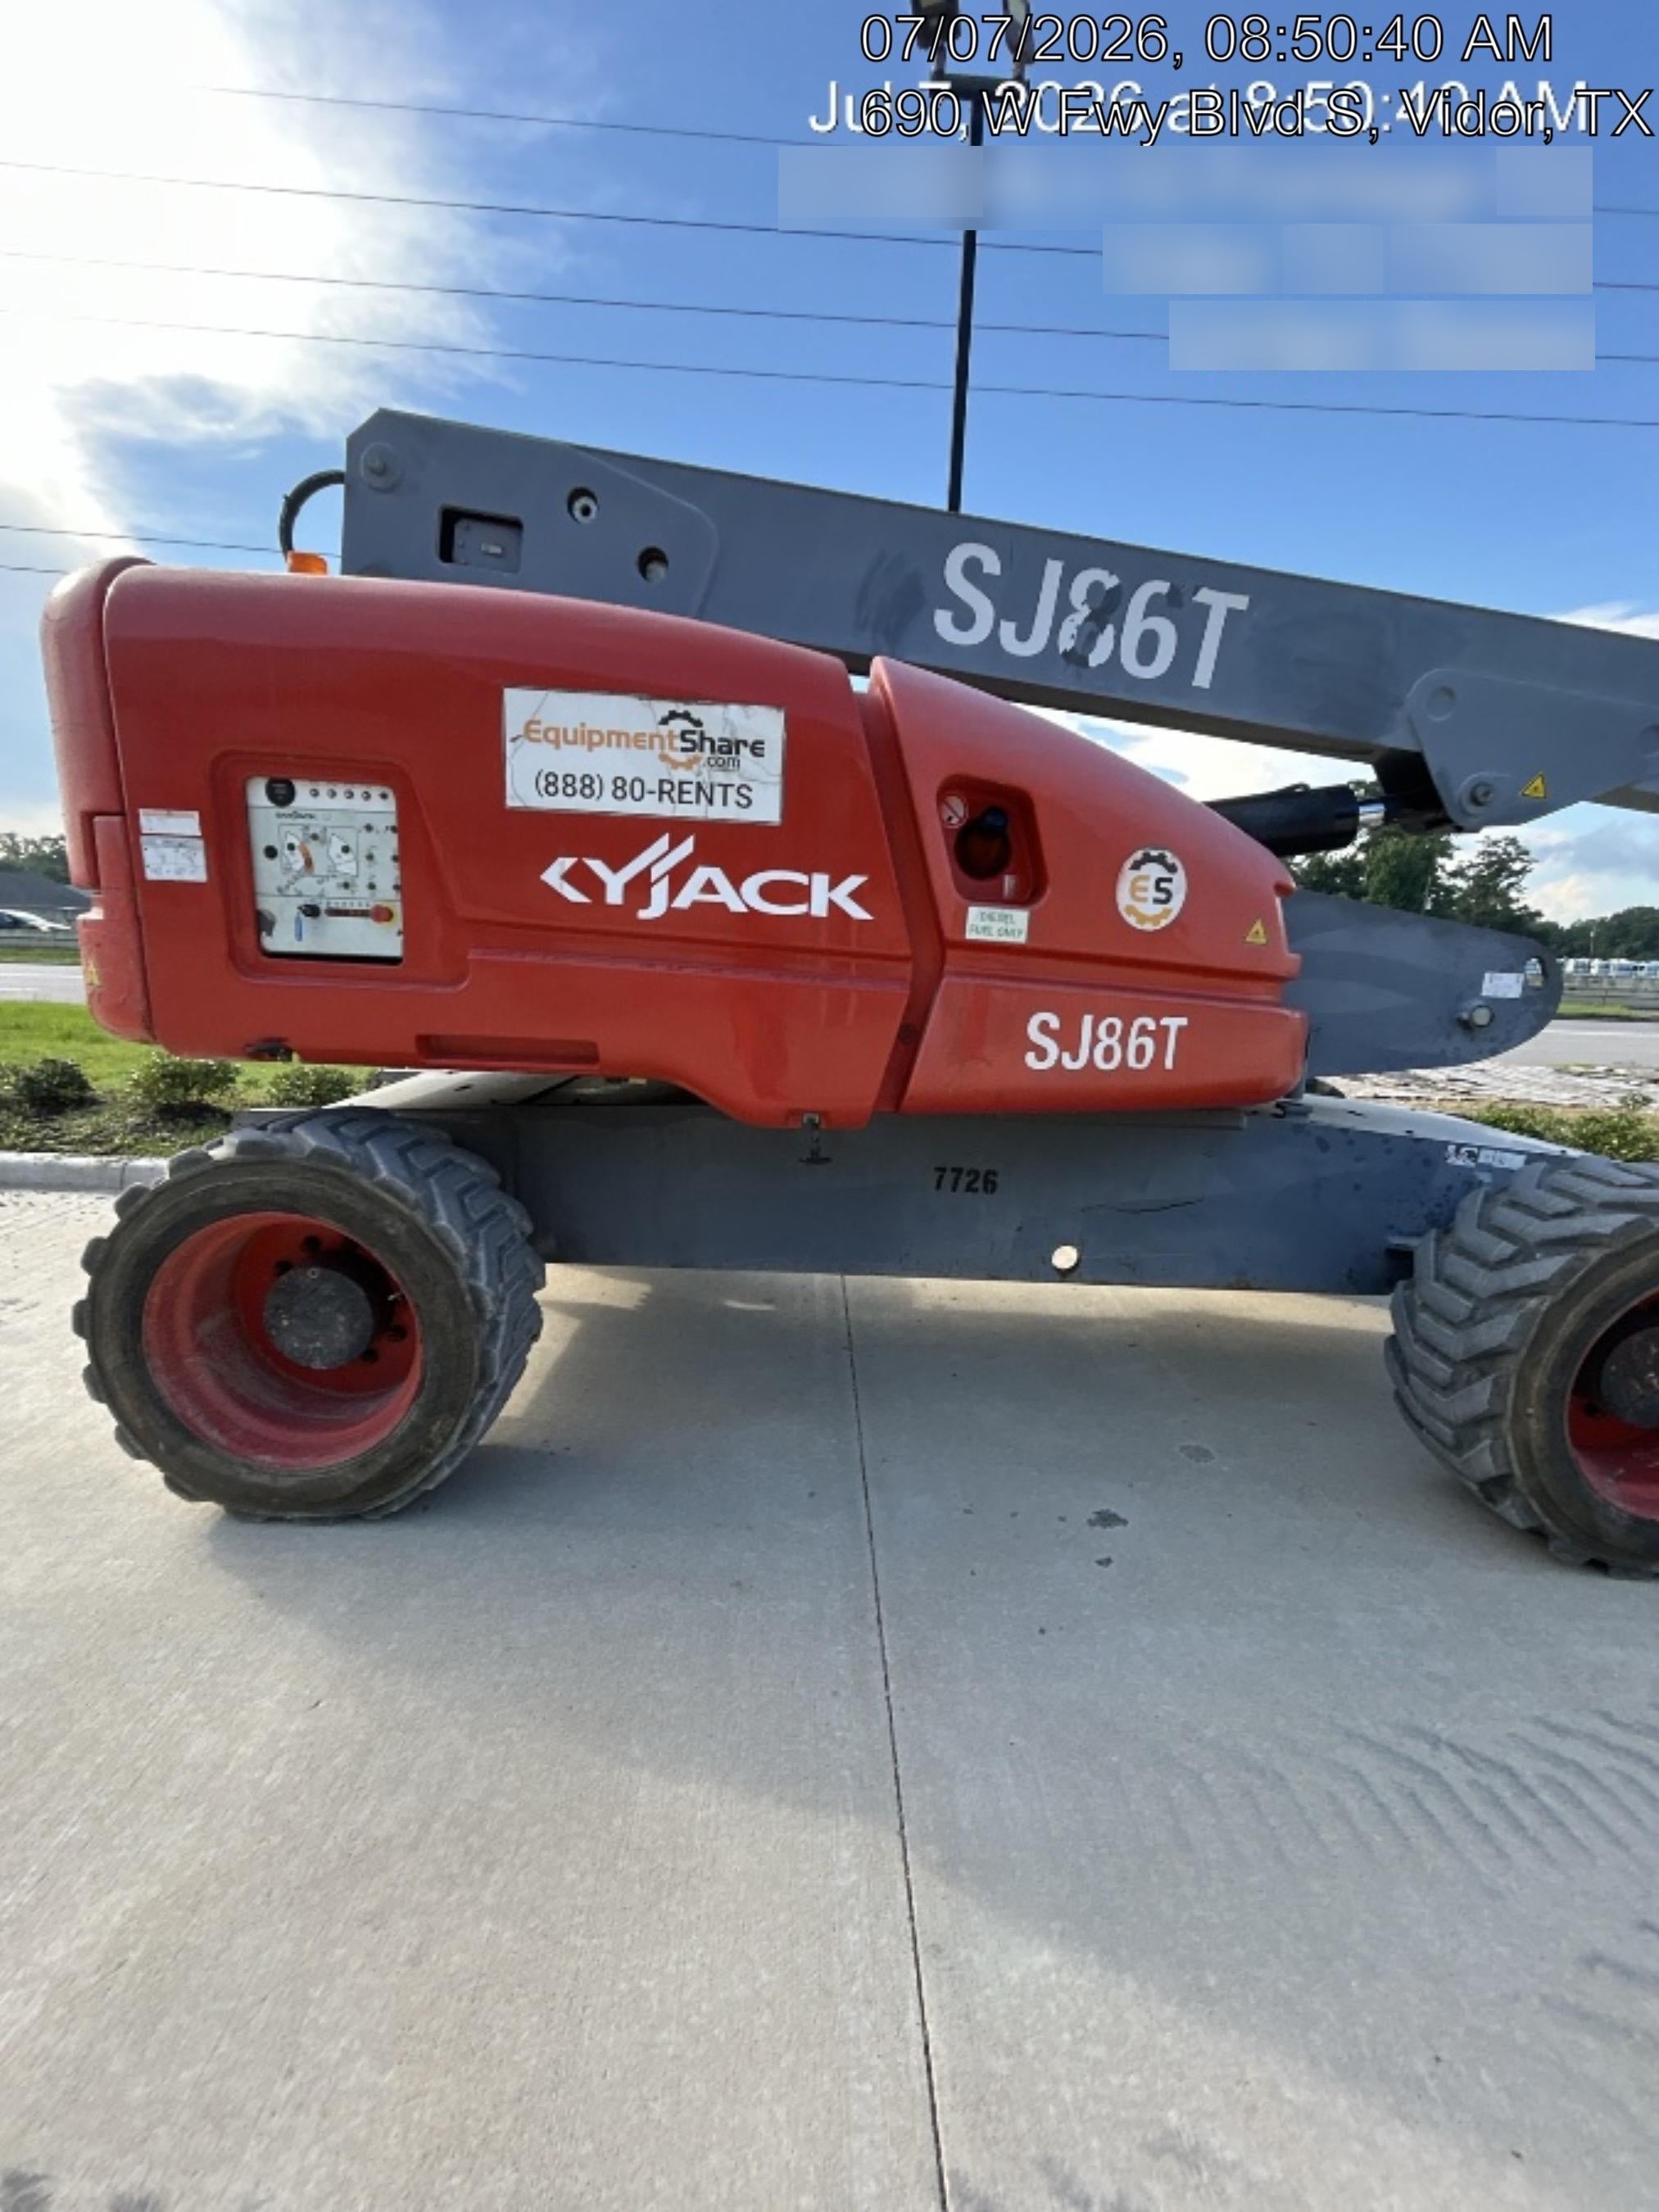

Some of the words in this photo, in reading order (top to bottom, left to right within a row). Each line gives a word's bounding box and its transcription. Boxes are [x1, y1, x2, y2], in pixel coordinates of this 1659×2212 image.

[933, 542, 1249, 689] SJ86T
[523, 718, 765, 759] EquipmentShare
[535, 768, 604, 800] (888)
[611, 776, 753, 809] 80-RENTS
[1025, 1012, 1188, 1070] SJ86T
[933, 1166, 998, 1194] 7726
